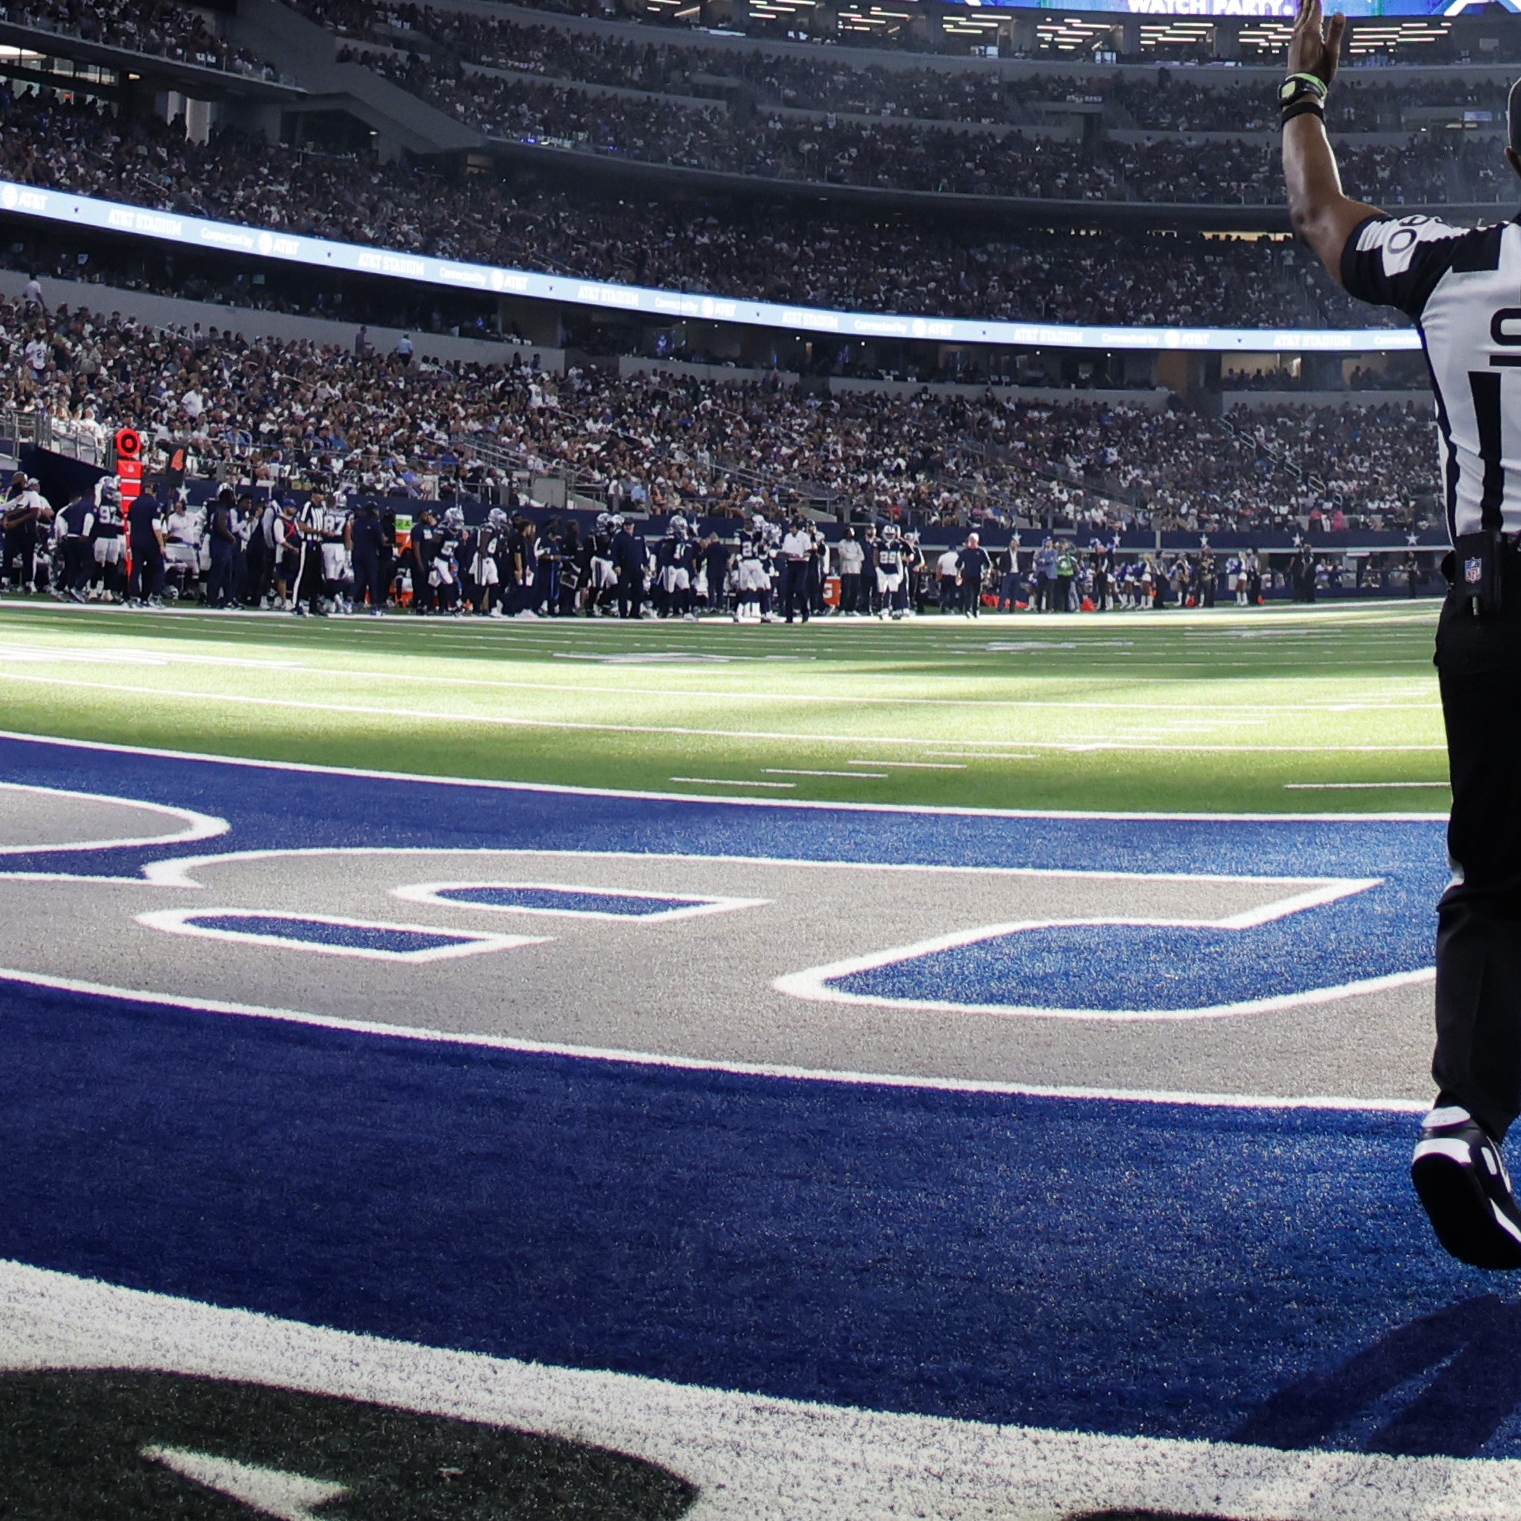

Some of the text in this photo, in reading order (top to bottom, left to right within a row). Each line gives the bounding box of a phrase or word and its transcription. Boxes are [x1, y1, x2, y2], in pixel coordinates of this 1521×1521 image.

[17, 191, 49, 211] AT&T
[106, 207, 183, 237] AT&T STADIUM
[272, 237, 301, 256] AT&T
[503, 273, 529, 291] AT&T
[927, 321, 954, 337] AT&T
[324, 514, 349, 535] 87
